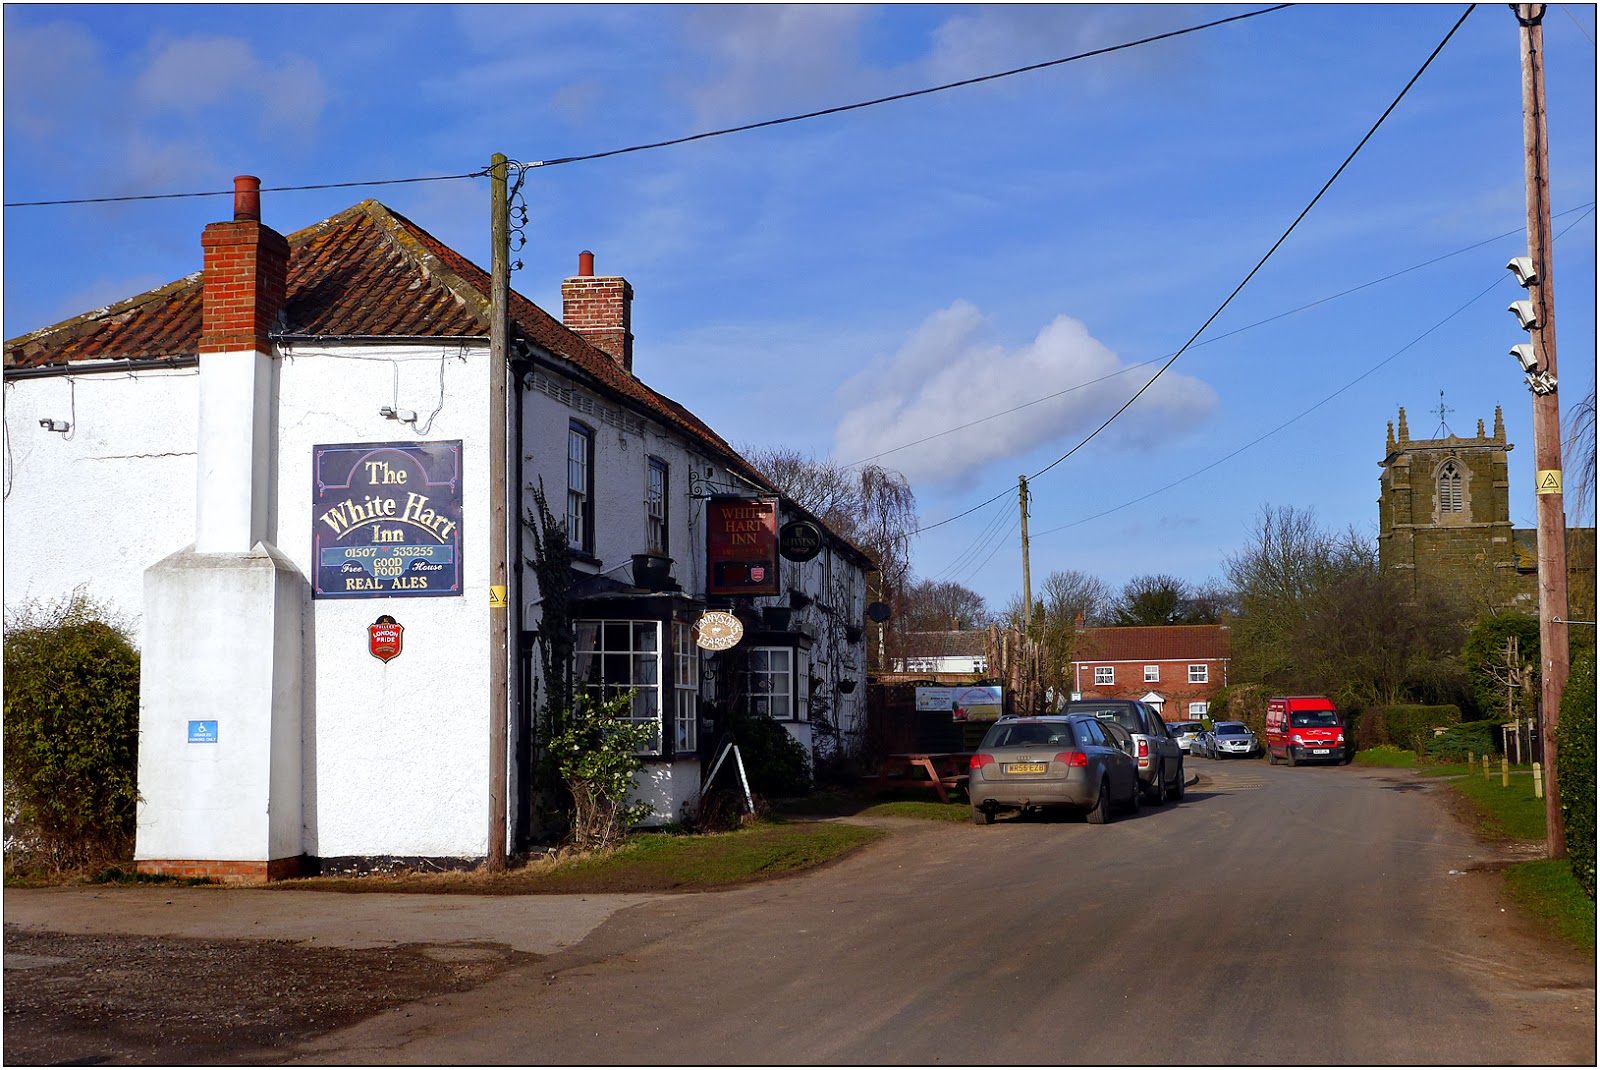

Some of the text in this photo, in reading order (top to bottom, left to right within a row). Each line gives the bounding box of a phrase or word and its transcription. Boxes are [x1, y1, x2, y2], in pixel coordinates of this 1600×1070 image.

[365, 461, 408, 485] The
[319, 491, 457, 540] White Hart
[722, 507, 766, 519] WHITE
[725, 520, 762, 532] HART
[371, 525, 405, 543] Inn
[731, 533, 757, 545] INN
[344, 546, 434, 558] 01507 533255
[340, 561, 443, 573] Free House
[373, 558, 403, 567] GOOD
[373, 567, 403, 576] FOOD
[345, 576, 428, 590] REAL ALES
[372, 630, 399, 638] LONDON
